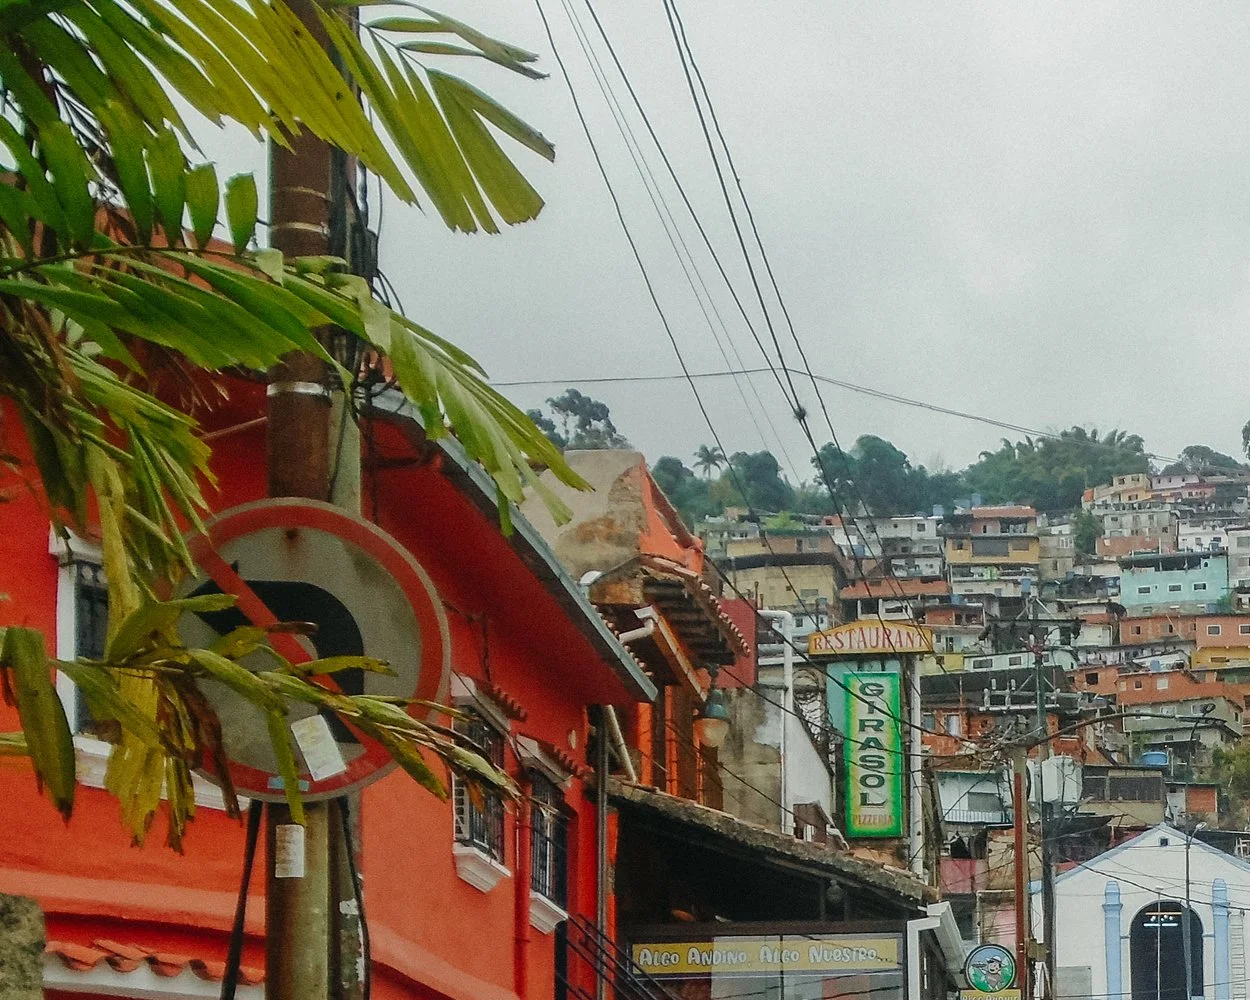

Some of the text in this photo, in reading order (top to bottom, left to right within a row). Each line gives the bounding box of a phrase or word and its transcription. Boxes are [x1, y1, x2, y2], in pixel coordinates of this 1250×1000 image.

[814, 626, 923, 650] RESTAURANT
[858, 682, 888, 807] GIRASOL
[853, 814, 894, 827] PIZZERIA
[639, 947, 680, 967] ALGO
[760, 945, 800, 963] ALGO
